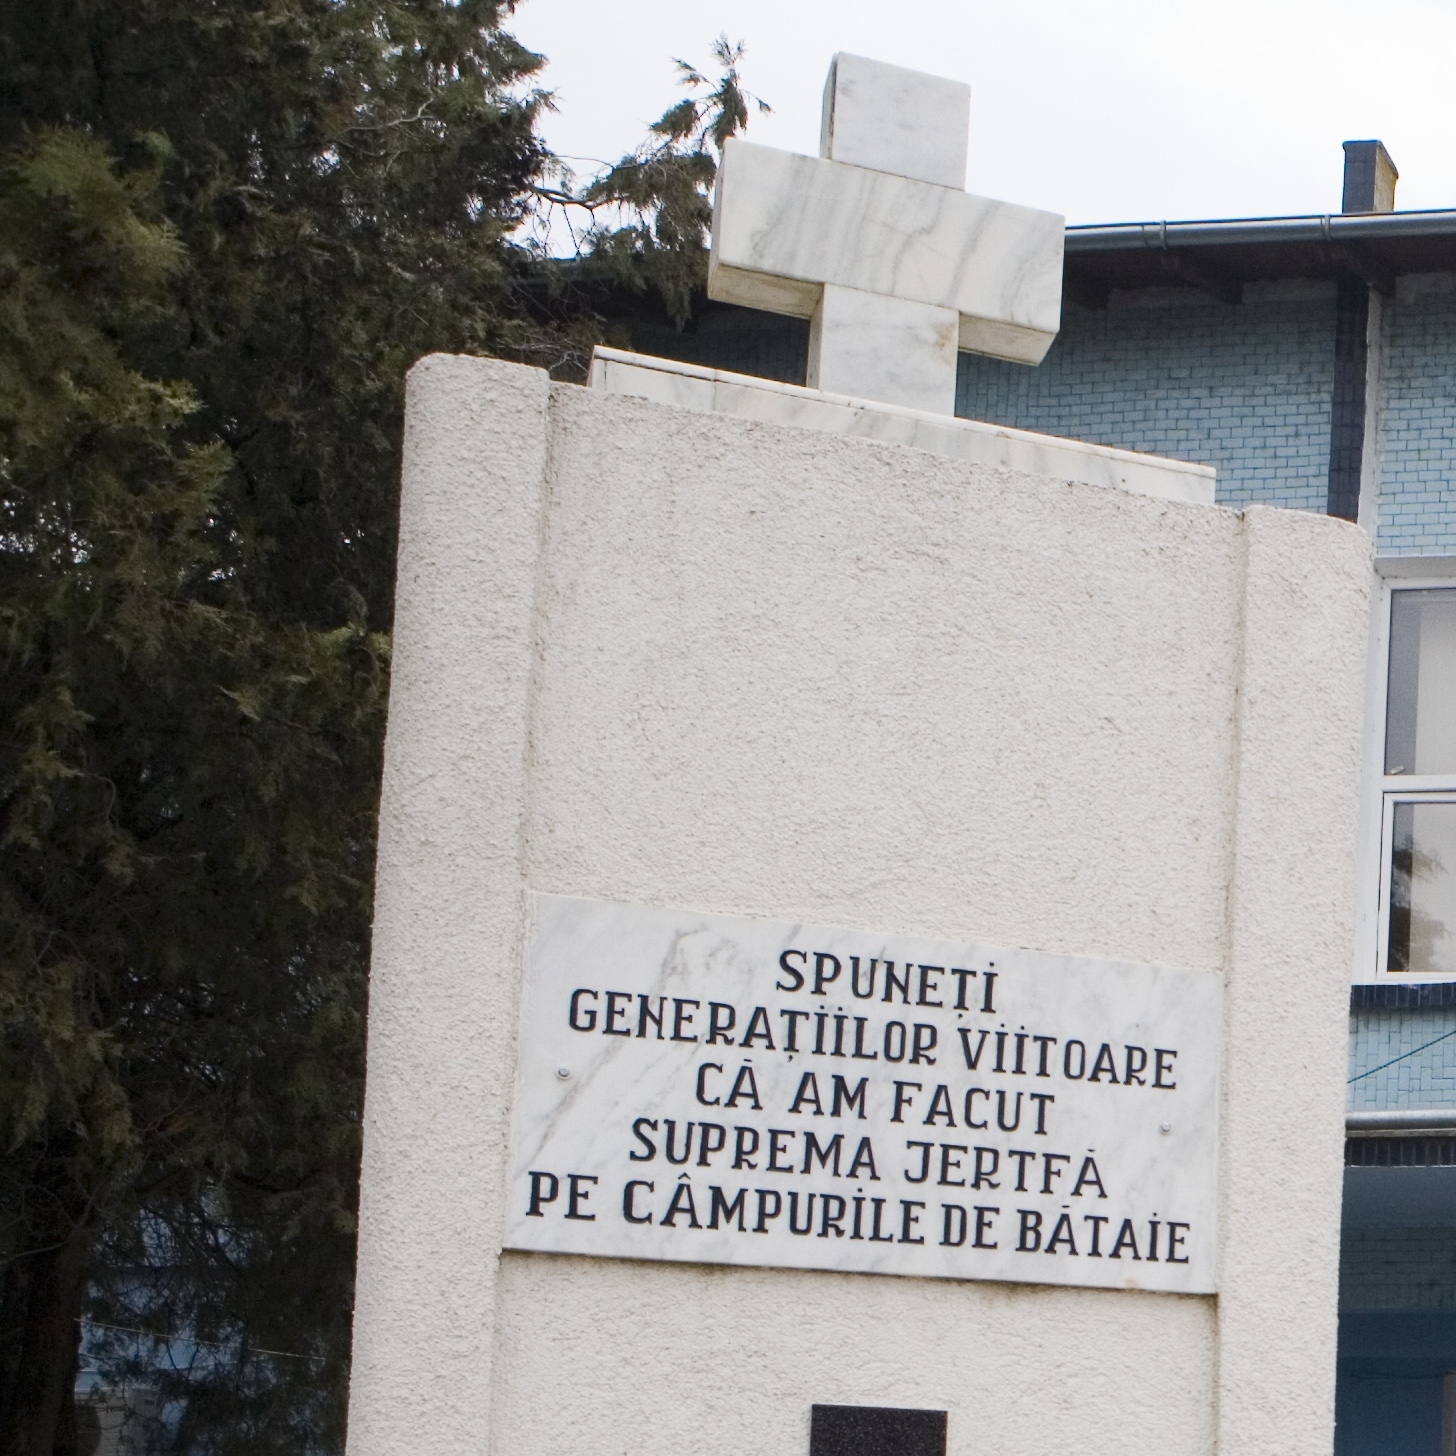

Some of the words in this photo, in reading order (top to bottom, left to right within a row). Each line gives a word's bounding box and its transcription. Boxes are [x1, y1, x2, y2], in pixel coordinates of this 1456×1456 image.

[957, 1022, 1178, 1090] VIITOARE
[788, 1072, 868, 1120] AM
[890, 1080, 1055, 1136] FACUT
[629, 1117, 881, 1182] SUPREMA
[525, 1170, 599, 1222] PE
[622, 1172, 926, 1246] CÂMPURILE
[938, 1203, 1000, 1250] DE
